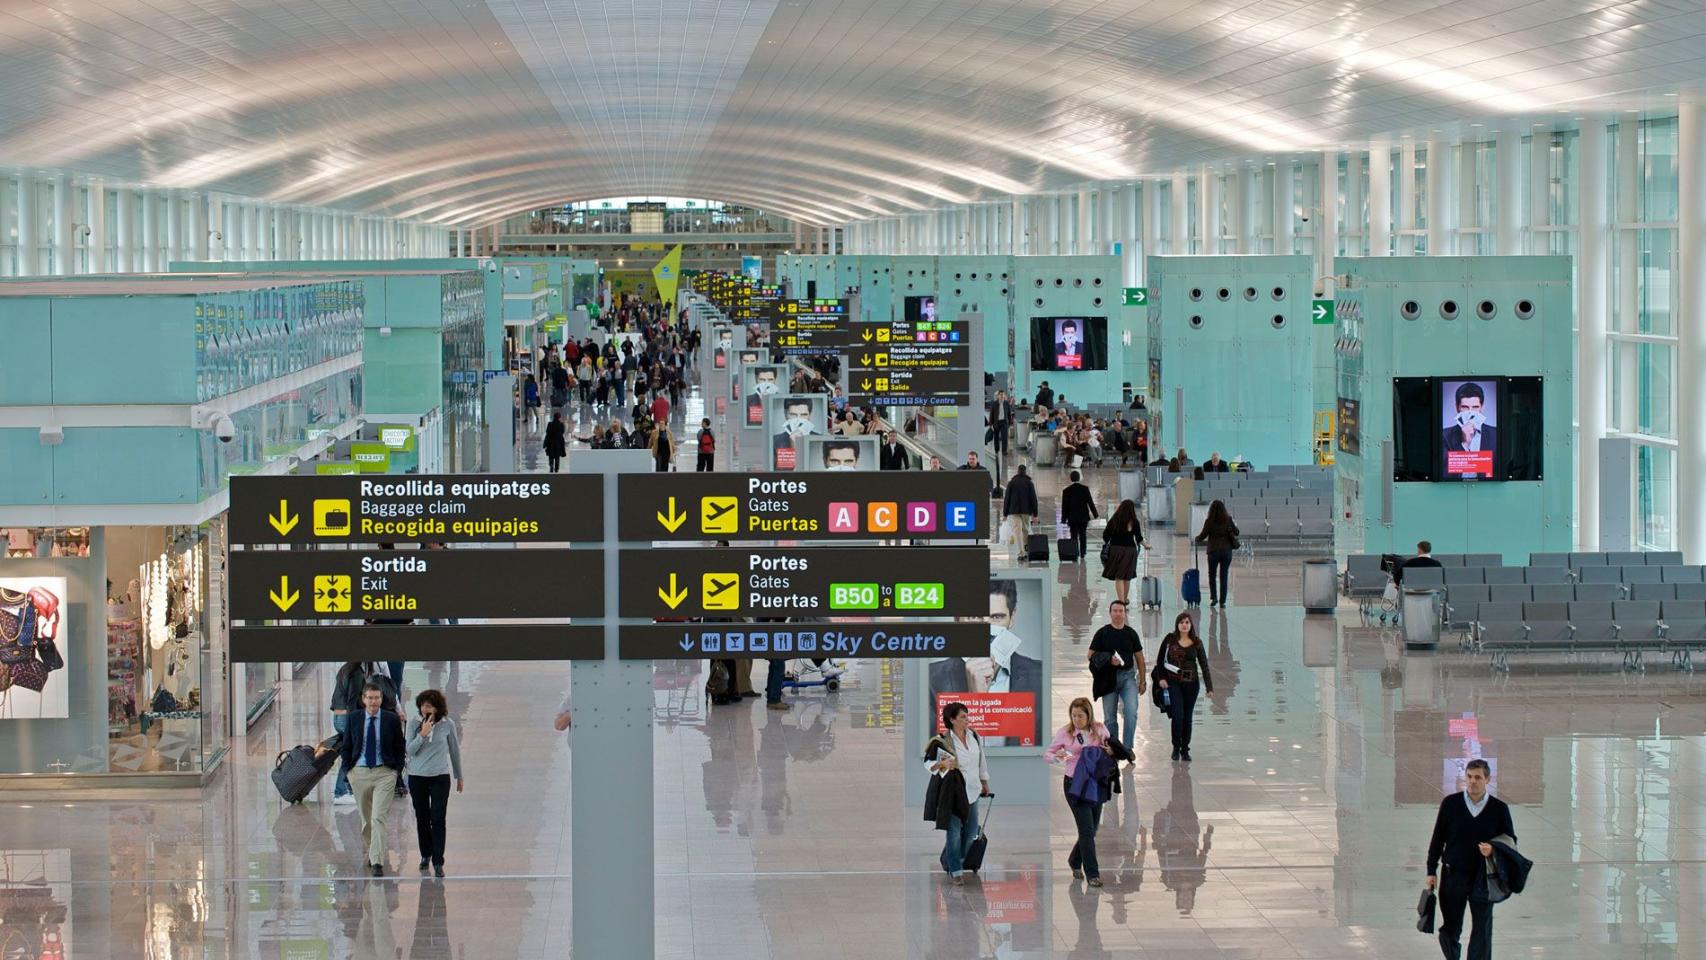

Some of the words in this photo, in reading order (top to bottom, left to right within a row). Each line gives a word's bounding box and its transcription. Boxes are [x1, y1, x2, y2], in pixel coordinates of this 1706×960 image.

[361, 481, 443, 496] Recollida
[451, 480, 550, 498] equipatges
[749, 478, 806, 493] Portes
[362, 501, 423, 516] Baggage
[429, 500, 465, 513] claim
[749, 498, 788, 511] Gates
[362, 519, 444, 536] Recogida
[453, 518, 538, 536] equipajes
[750, 516, 817, 531] Puertas
[836, 508, 851, 527] A
[875, 507, 890, 527] C
[915, 507, 929, 526] D
[954, 507, 966, 526] E
[362, 557, 426, 572] Sortida
[750, 555, 807, 570] Portes
[362, 577, 387, 590] Exit
[750, 575, 789, 588] Gates
[882, 586, 892, 595] to
[363, 595, 416, 610] Salida
[750, 593, 818, 607] Puertas
[835, 588, 873, 604] B50
[901, 588, 938, 604] B24
[822, 632, 862, 655] Sky
[871, 632, 945, 650] Centre
